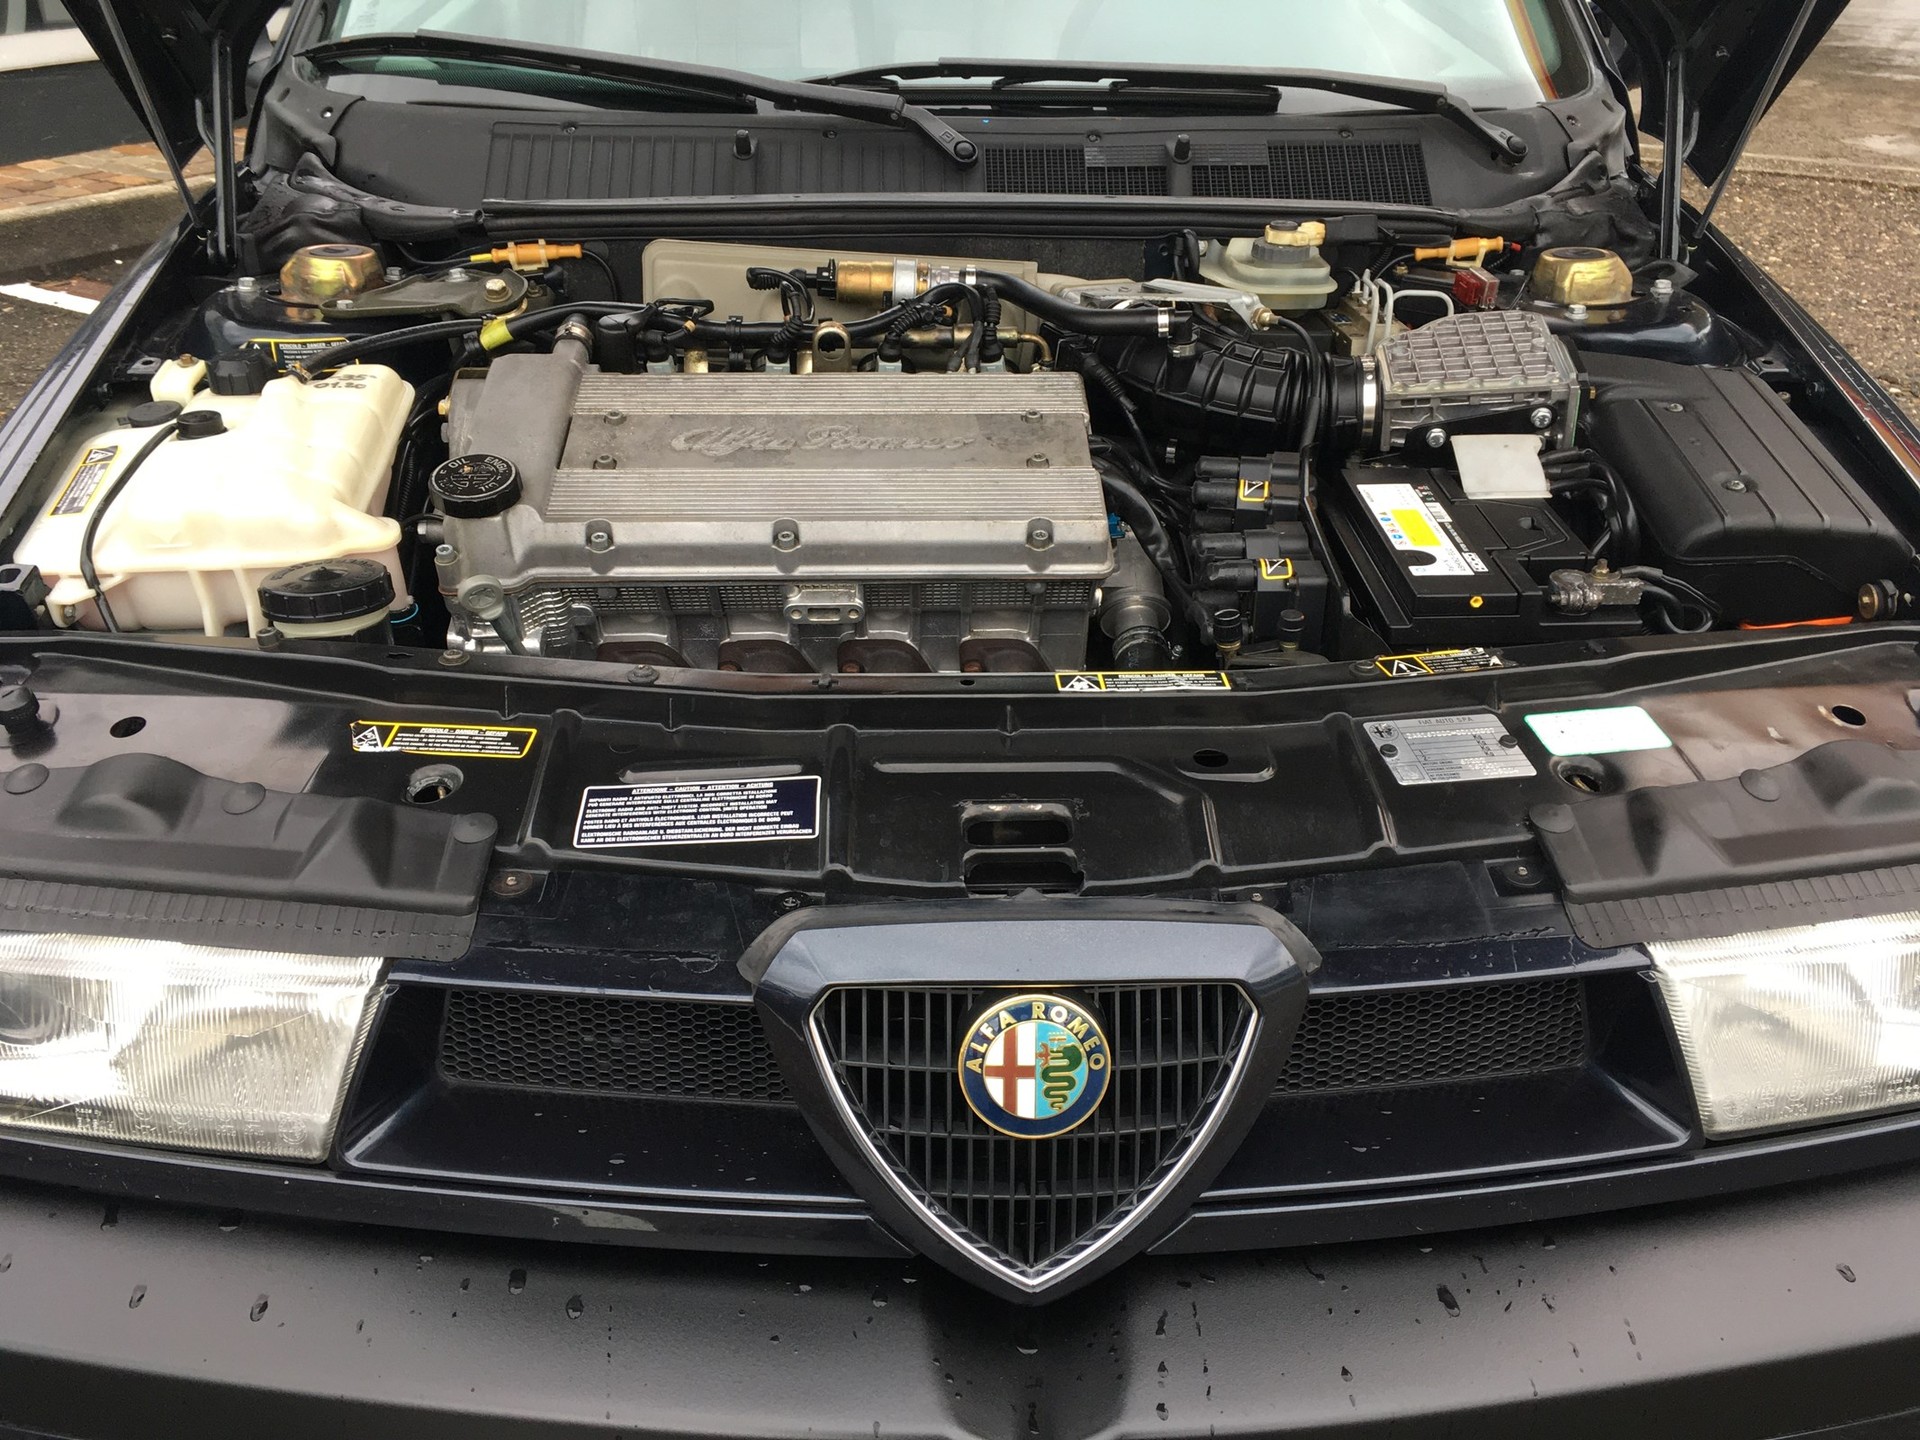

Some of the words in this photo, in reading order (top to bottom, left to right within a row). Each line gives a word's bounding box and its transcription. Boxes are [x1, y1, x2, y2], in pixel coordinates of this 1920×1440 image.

[670, 426, 796, 456] Alfa
[801, 424, 975, 450] Romeo
[448, 457, 470, 468] OIL
[966, 1010, 1018, 1074] ALFA
[1031, 1002, 1106, 1070] ROMEO
